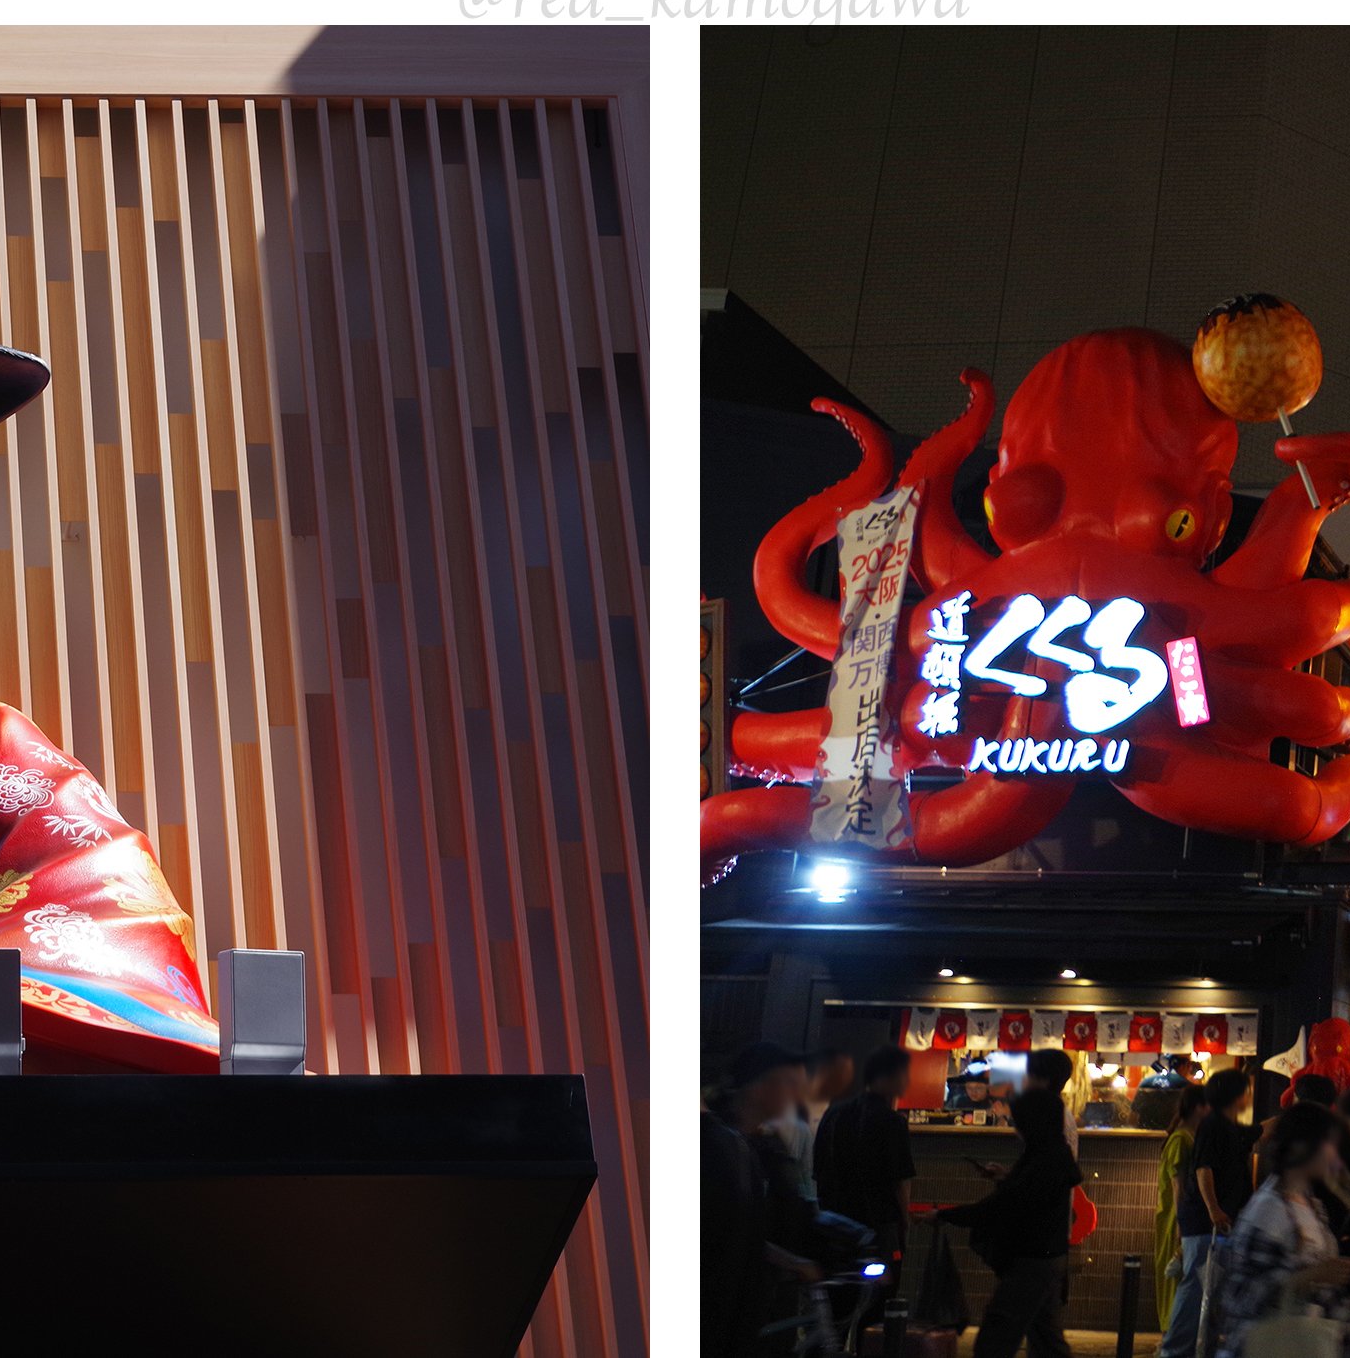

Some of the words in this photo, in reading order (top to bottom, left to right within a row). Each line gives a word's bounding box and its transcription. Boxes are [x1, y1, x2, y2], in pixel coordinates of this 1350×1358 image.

[852, 538, 909, 582] 2025
[964, 594, 1169, 734] くくる
[843, 690, 881, 839] 出店決定
[969, 737, 1130, 773] KUKURU
